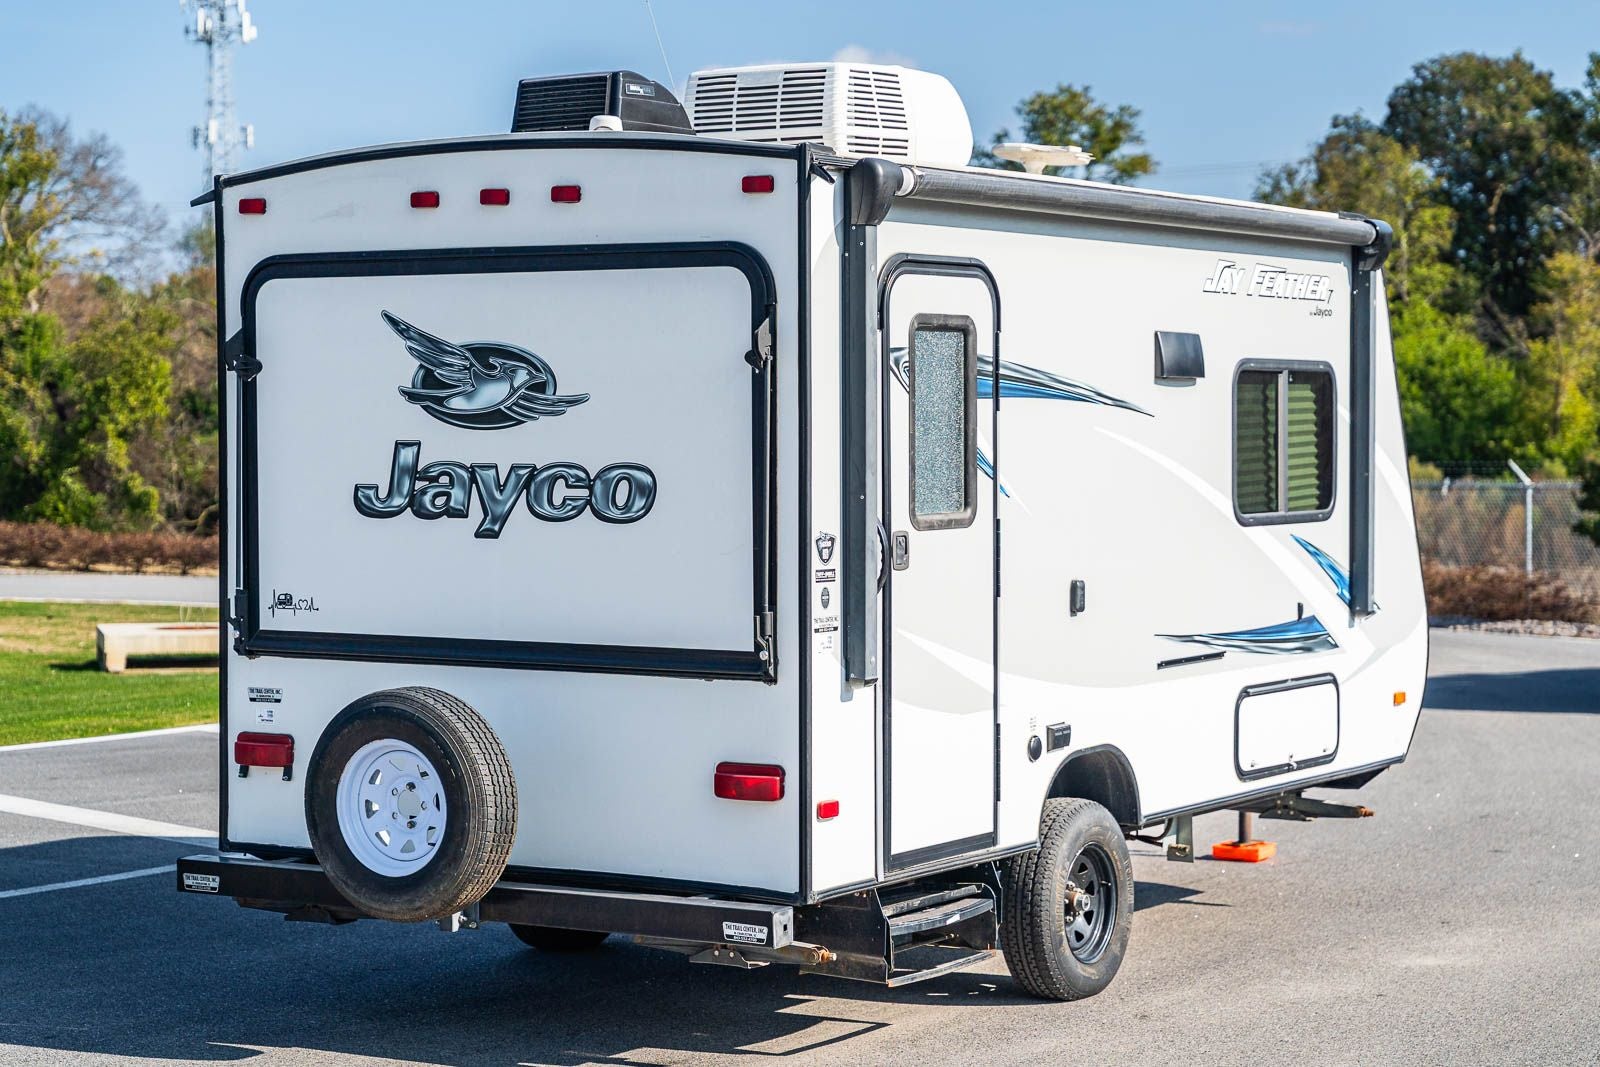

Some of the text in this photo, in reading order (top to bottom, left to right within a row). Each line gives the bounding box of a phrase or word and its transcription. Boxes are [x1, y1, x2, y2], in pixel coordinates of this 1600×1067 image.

[1247, 263, 1329, 301] FEATHER
[1314, 305, 1333, 318] Jayco
[353, 440, 657, 539] Jayco
